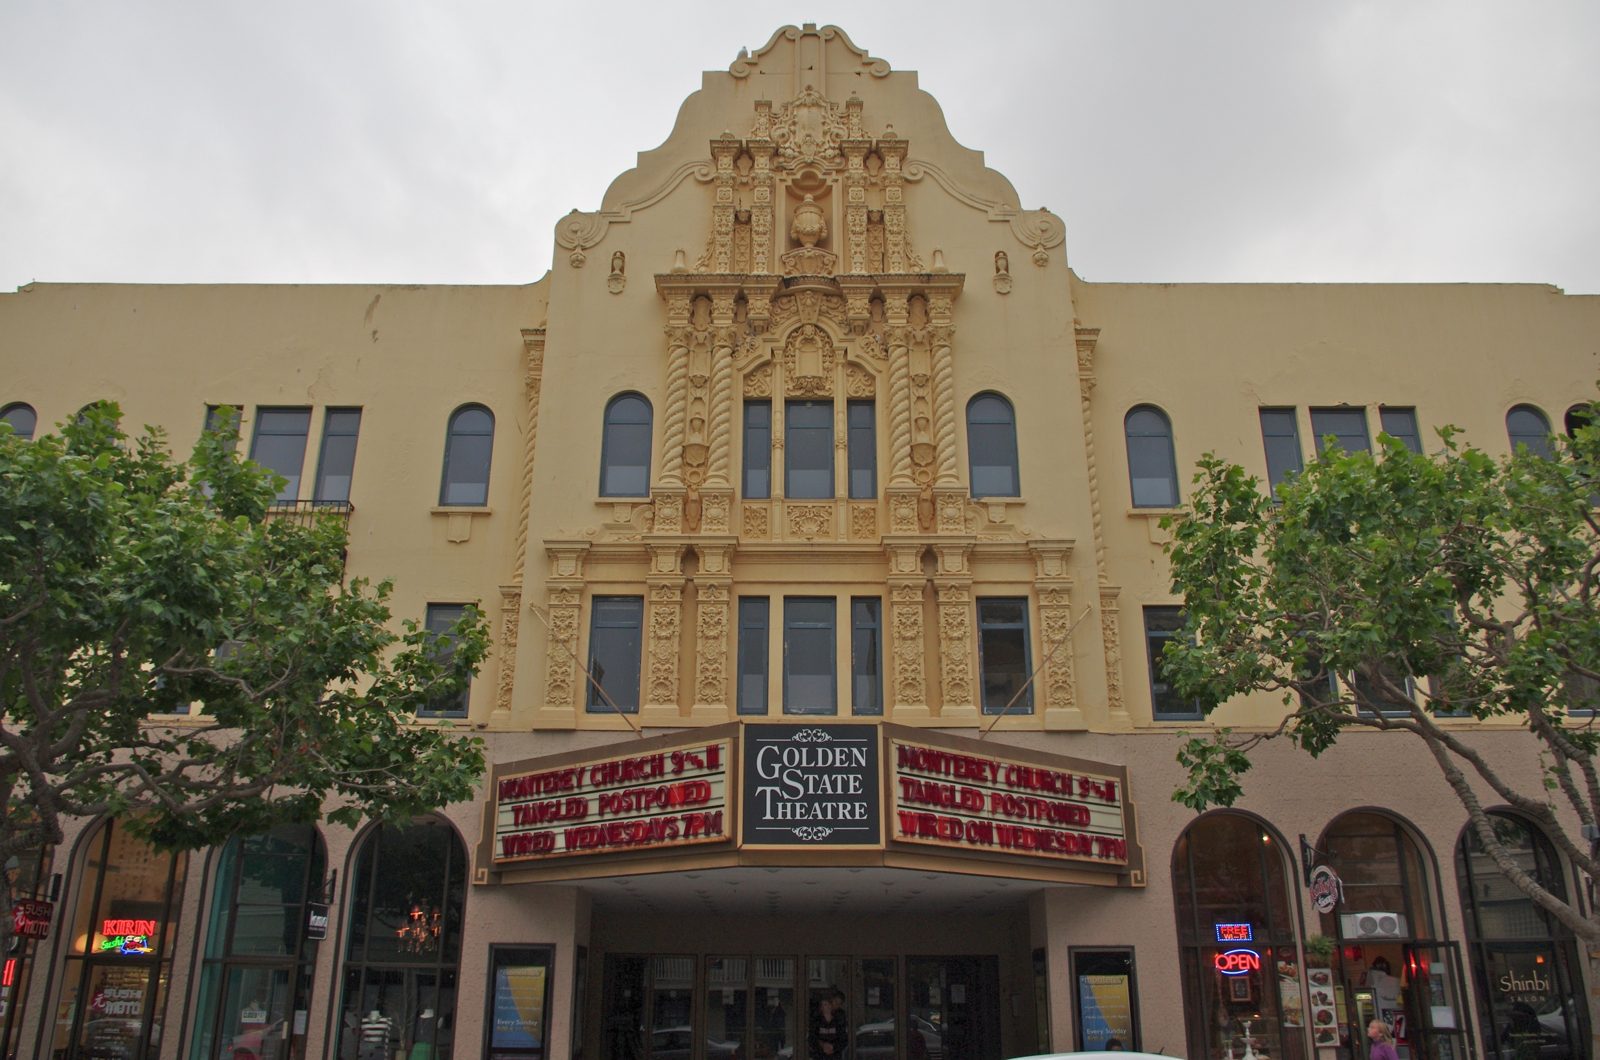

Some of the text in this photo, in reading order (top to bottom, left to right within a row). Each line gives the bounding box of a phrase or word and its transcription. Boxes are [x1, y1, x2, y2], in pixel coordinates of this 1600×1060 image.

[499, 766, 586, 801] MONTEREY
[590, 753, 665, 788] CHURCH
[671, 750, 685, 775] 9
[756, 745, 868, 780] GOLDEN
[897, 744, 1001, 784] MONTEREY
[1005, 763, 1073, 797] CHURCH
[1079, 775, 1090, 798] 9
[781, 768, 863, 800] STATE
[511, 779, 712, 827] TANGLED POSTPONED
[755, 786, 868, 820] THEATRE
[898, 776, 1091, 828] TANGLED POSTPONED
[502, 810, 724, 858] WIRED WEDNESDAYS 7PM
[897, 810, 964, 841] WIRED
[965, 819, 994, 846] ON
[995, 823, 1095, 857] WEDNESDAY
[103, 919, 156, 936] KIRIN
[1220, 926, 1248, 935] FREE
[1215, 954, 1260, 970] OPEN
[103, 988, 143, 999] SUSHI
[1500, 970, 1550, 992] Shinbi
[104, 1000, 142, 1015] MOTO
